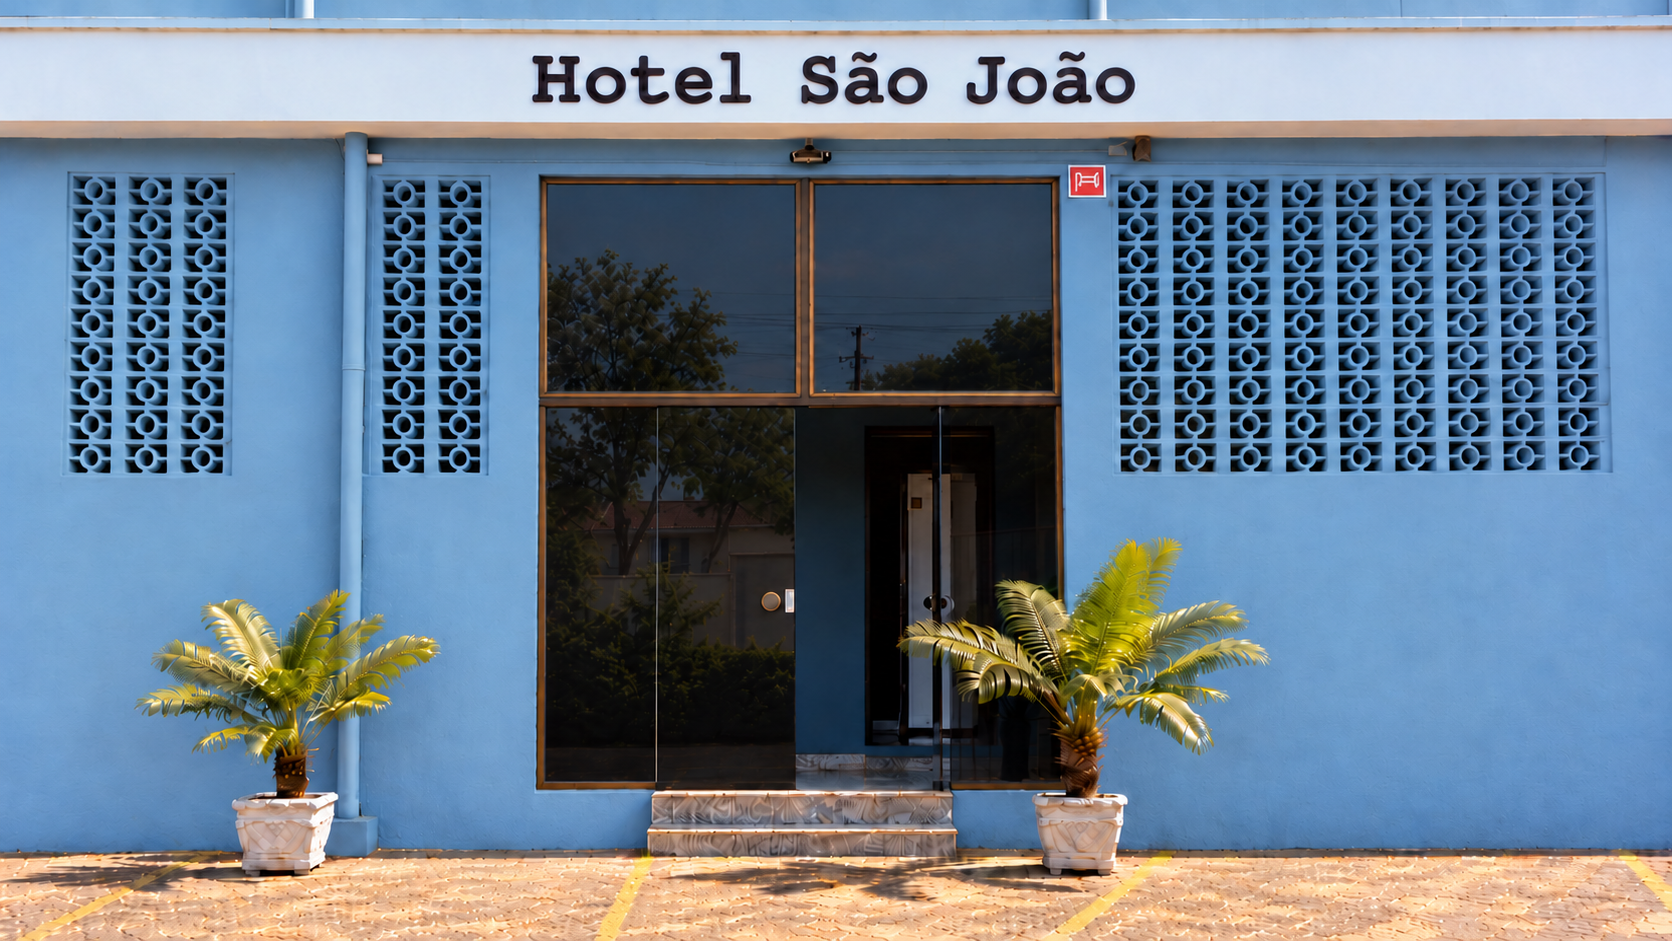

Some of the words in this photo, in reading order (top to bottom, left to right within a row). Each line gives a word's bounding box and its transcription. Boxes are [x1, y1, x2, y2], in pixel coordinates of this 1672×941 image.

[531, 52, 752, 105] Hotel
[800, 51, 928, 105] São
[966, 51, 1136, 105] João
